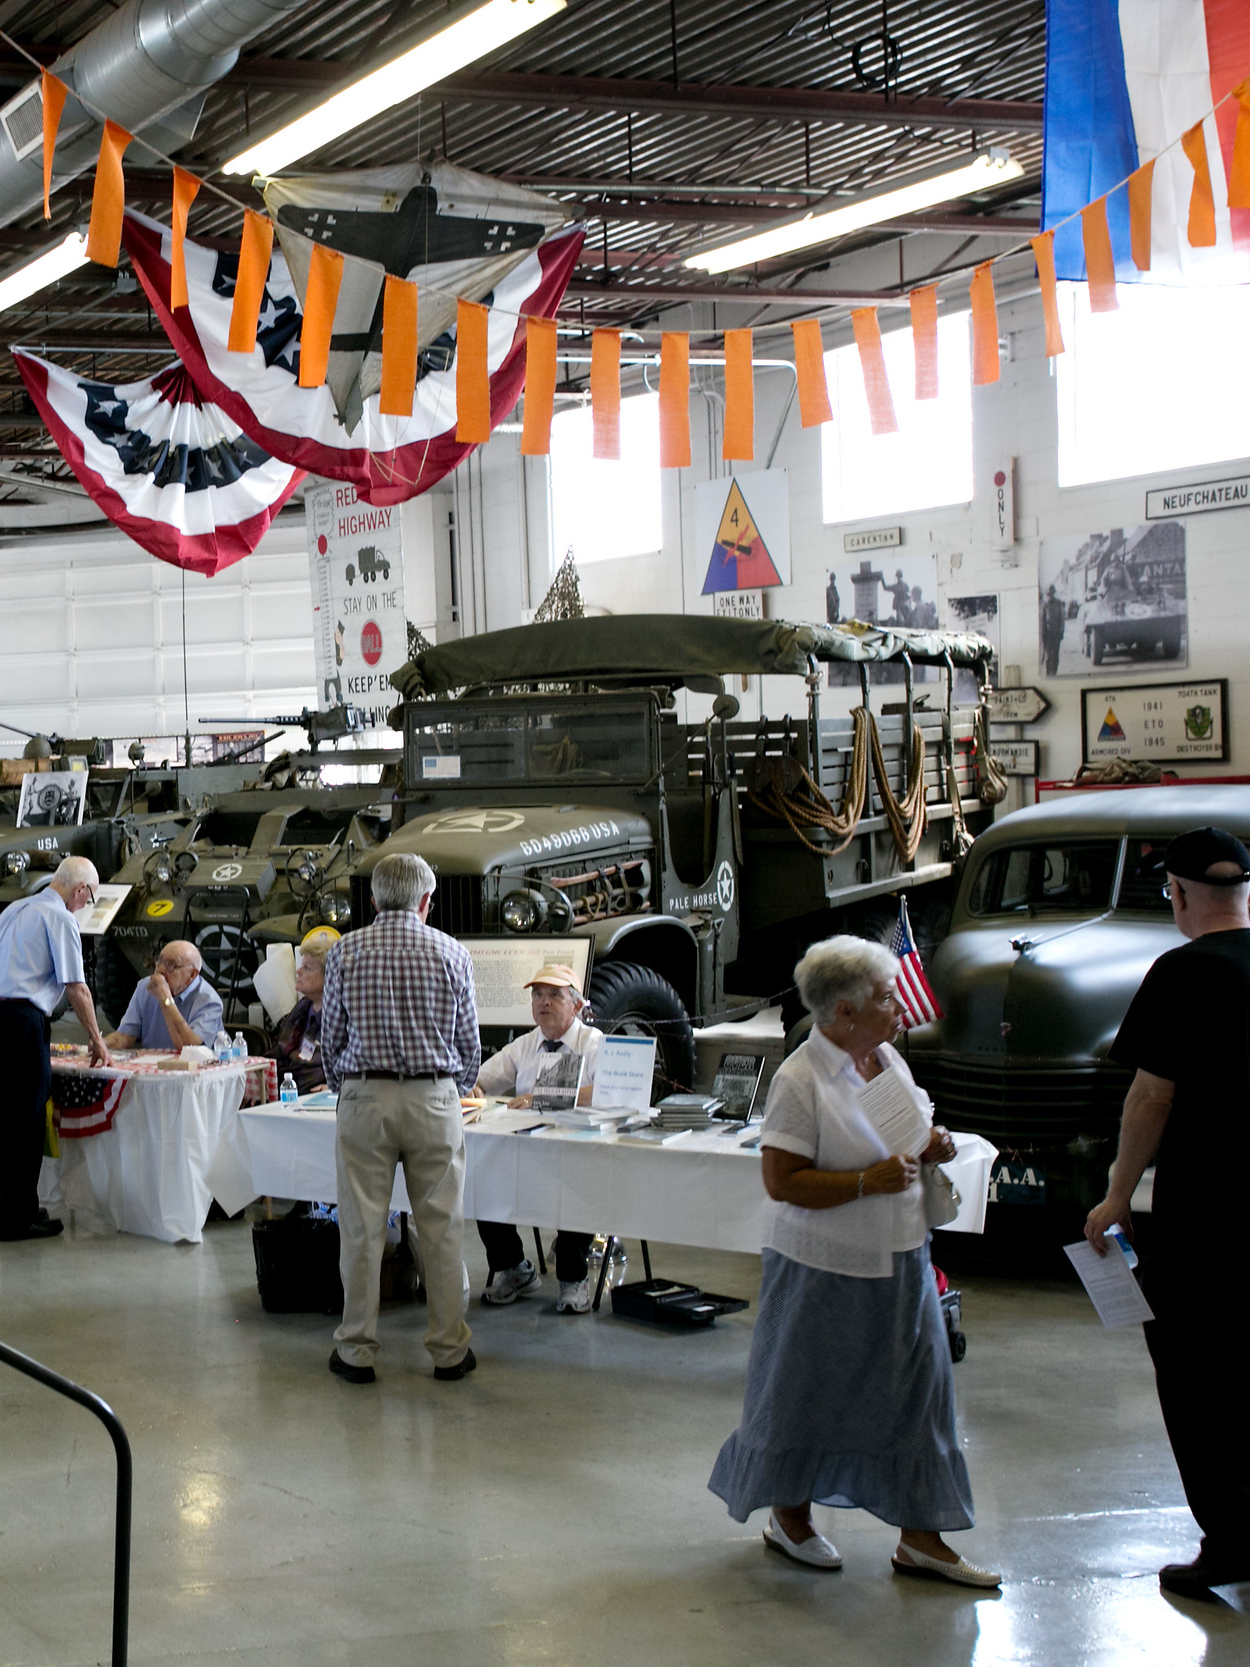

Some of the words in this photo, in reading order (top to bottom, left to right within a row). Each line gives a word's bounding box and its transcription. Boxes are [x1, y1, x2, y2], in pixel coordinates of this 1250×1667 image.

[336, 485, 359, 508] RED
[1163, 484, 1249, 510] NEUFCHATEAU
[730, 508, 739, 527] 4
[997, 488, 1005, 537] ONLY
[338, 508, 392, 537] HIGHWAY
[850, 534, 894, 547] CARENTAN
[343, 597, 362, 615] STAY
[366, 594, 377, 611] ON
[382, 591, 397, 608] THE
[720, 596, 736, 608] ONE
[739, 594, 756, 606] WAY
[361, 634, 382, 653] BALL
[1200, 688, 1218, 697] TANK
[1143, 702, 1163, 711] 1941
[1144, 737, 1165, 747] 1945
[992, 747, 1029, 757] NORMANDIE
[592, 819, 621, 840] USA
[37, 837, 59, 850] USA
[154, 902, 167, 914] 7
[669, 897, 690, 911] PALE
[692, 891, 718, 907] HORSE
[111, 925, 148, 938] 704TD
